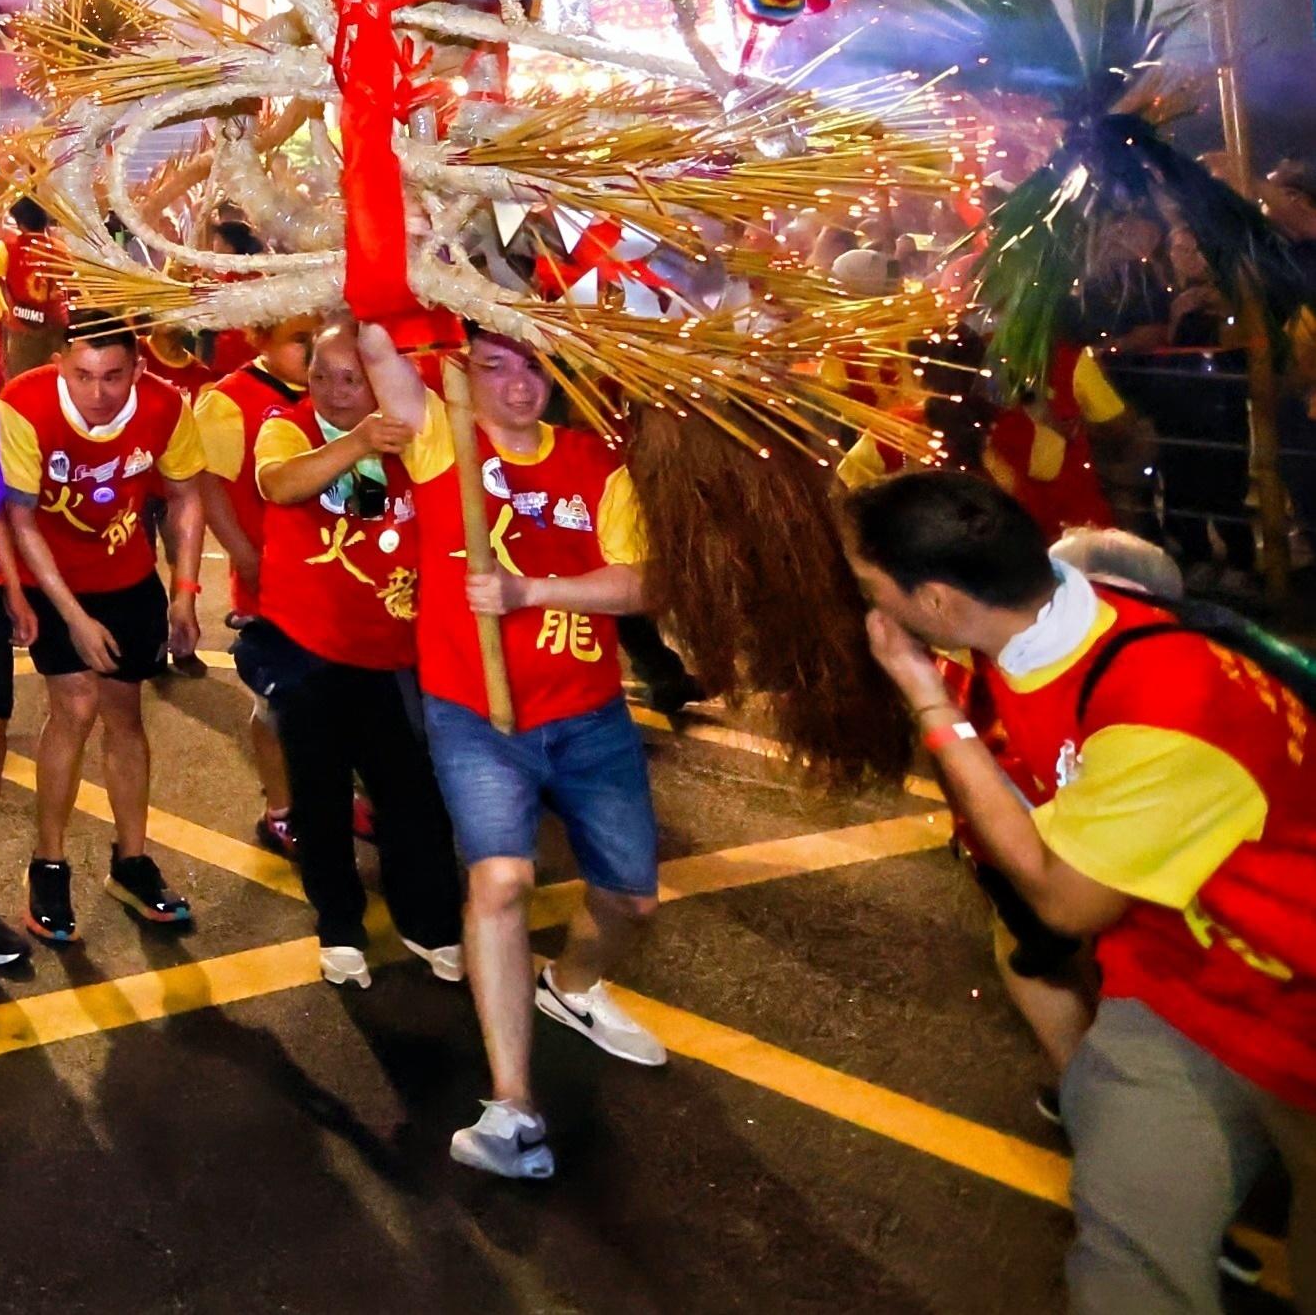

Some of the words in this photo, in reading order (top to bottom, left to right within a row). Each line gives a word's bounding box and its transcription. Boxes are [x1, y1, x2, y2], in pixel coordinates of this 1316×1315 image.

[12, 305, 45, 325] CHUMS
[39, 485, 96, 533] 火
[304, 516, 376, 586] 火
